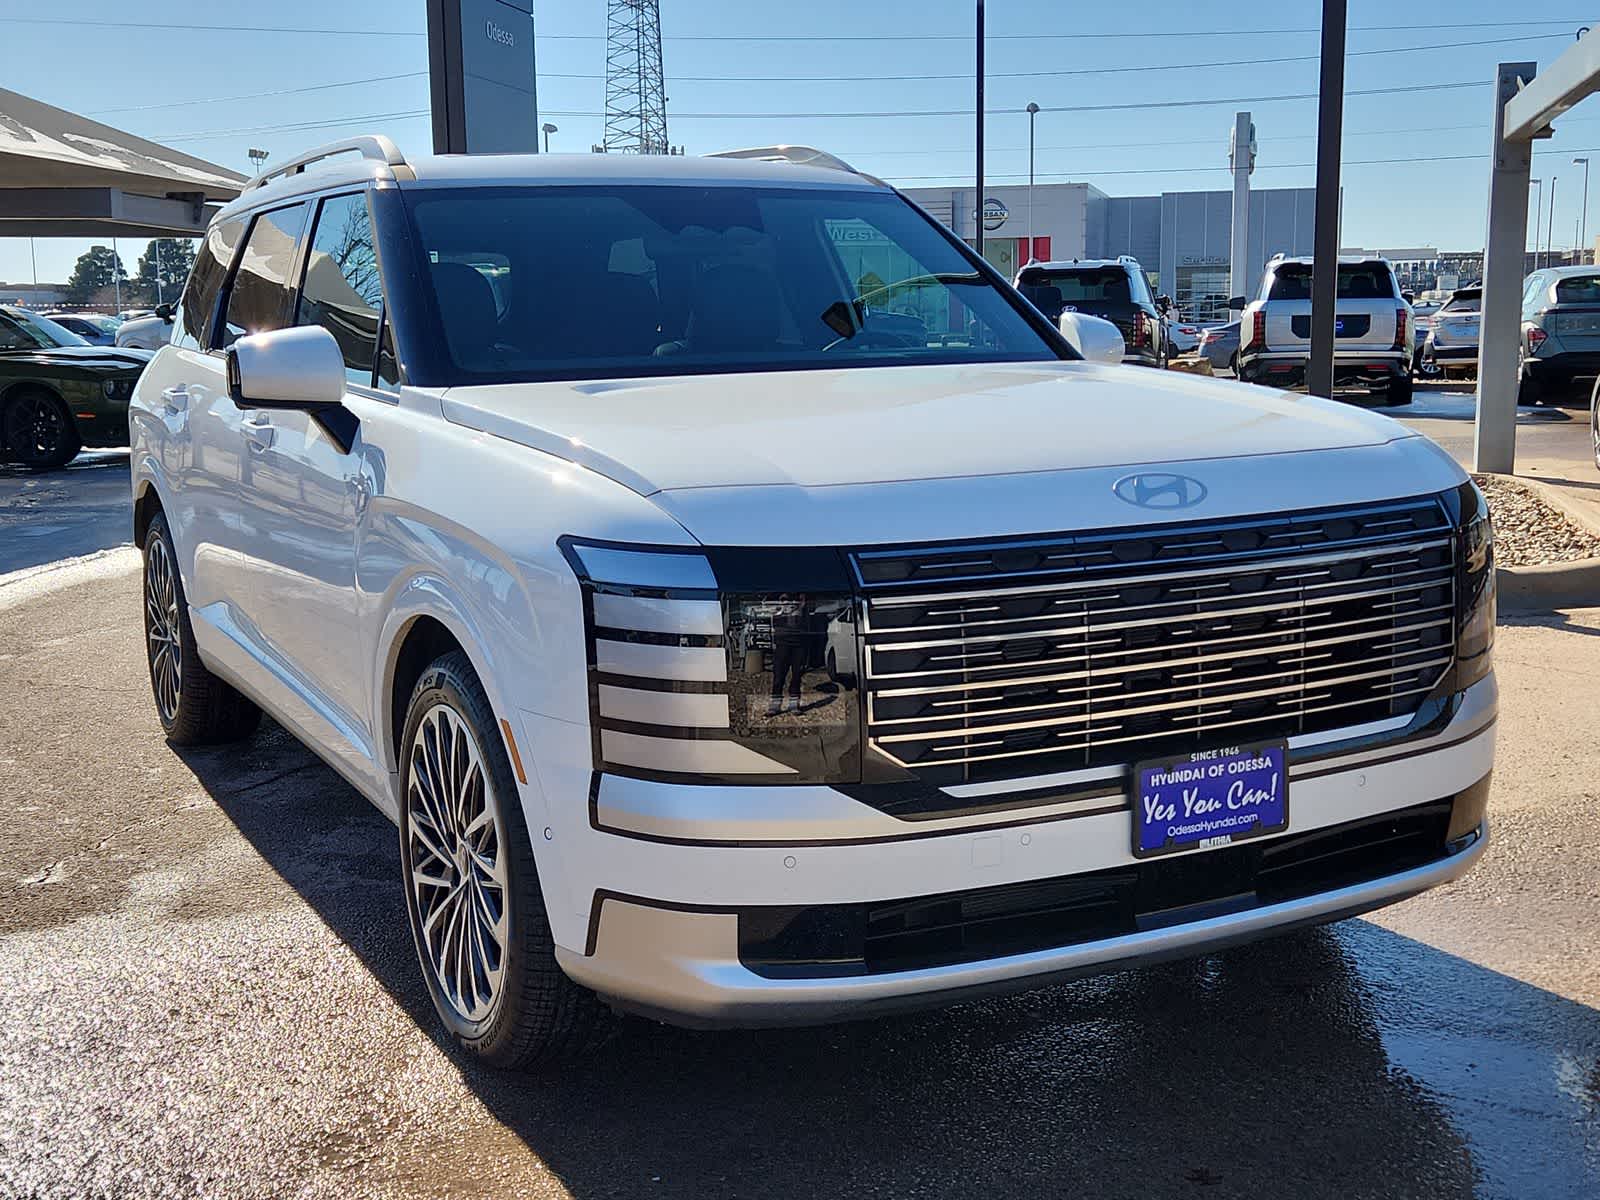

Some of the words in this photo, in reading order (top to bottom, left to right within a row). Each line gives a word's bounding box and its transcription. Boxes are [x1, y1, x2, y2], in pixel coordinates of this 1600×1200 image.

[486, 21, 514, 47] Odessa
[827, 225, 874, 241] West
[1190, 750, 1217, 762] SINCE
[1219, 746, 1240, 758] 1946
[1151, 769, 1205, 787] HYUNDAI
[1208, 765, 1225, 778] OF
[1228, 757, 1273, 774] ODESSA
[1143, 793, 1177, 825] Yes
[1182, 787, 1222, 818] You
[1226, 772, 1279, 810] Can!
[1167, 813, 1259, 837] OdessaHyundai.com
